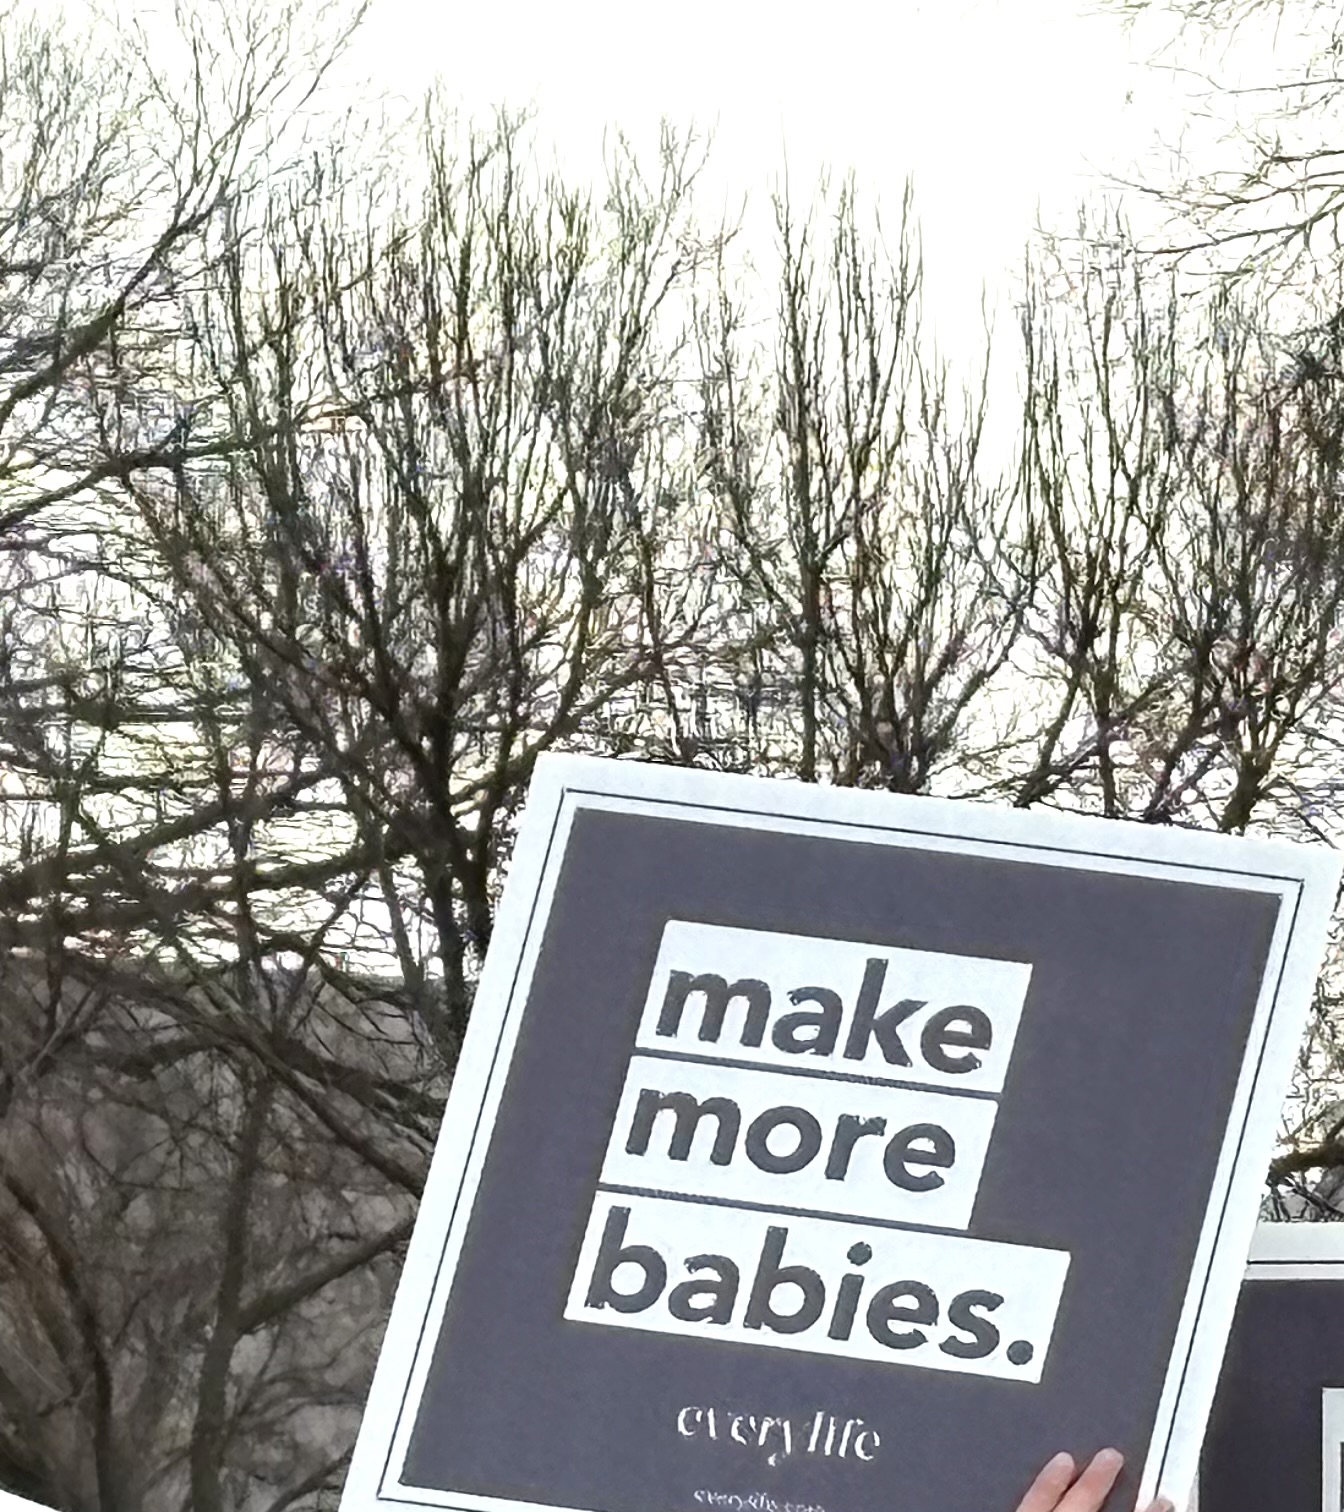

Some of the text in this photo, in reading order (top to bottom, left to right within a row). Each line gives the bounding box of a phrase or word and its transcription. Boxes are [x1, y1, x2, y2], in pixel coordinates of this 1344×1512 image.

[657, 960, 992, 1075] make
[625, 1087, 955, 1193] more
[586, 1205, 1035, 1367] babies.
